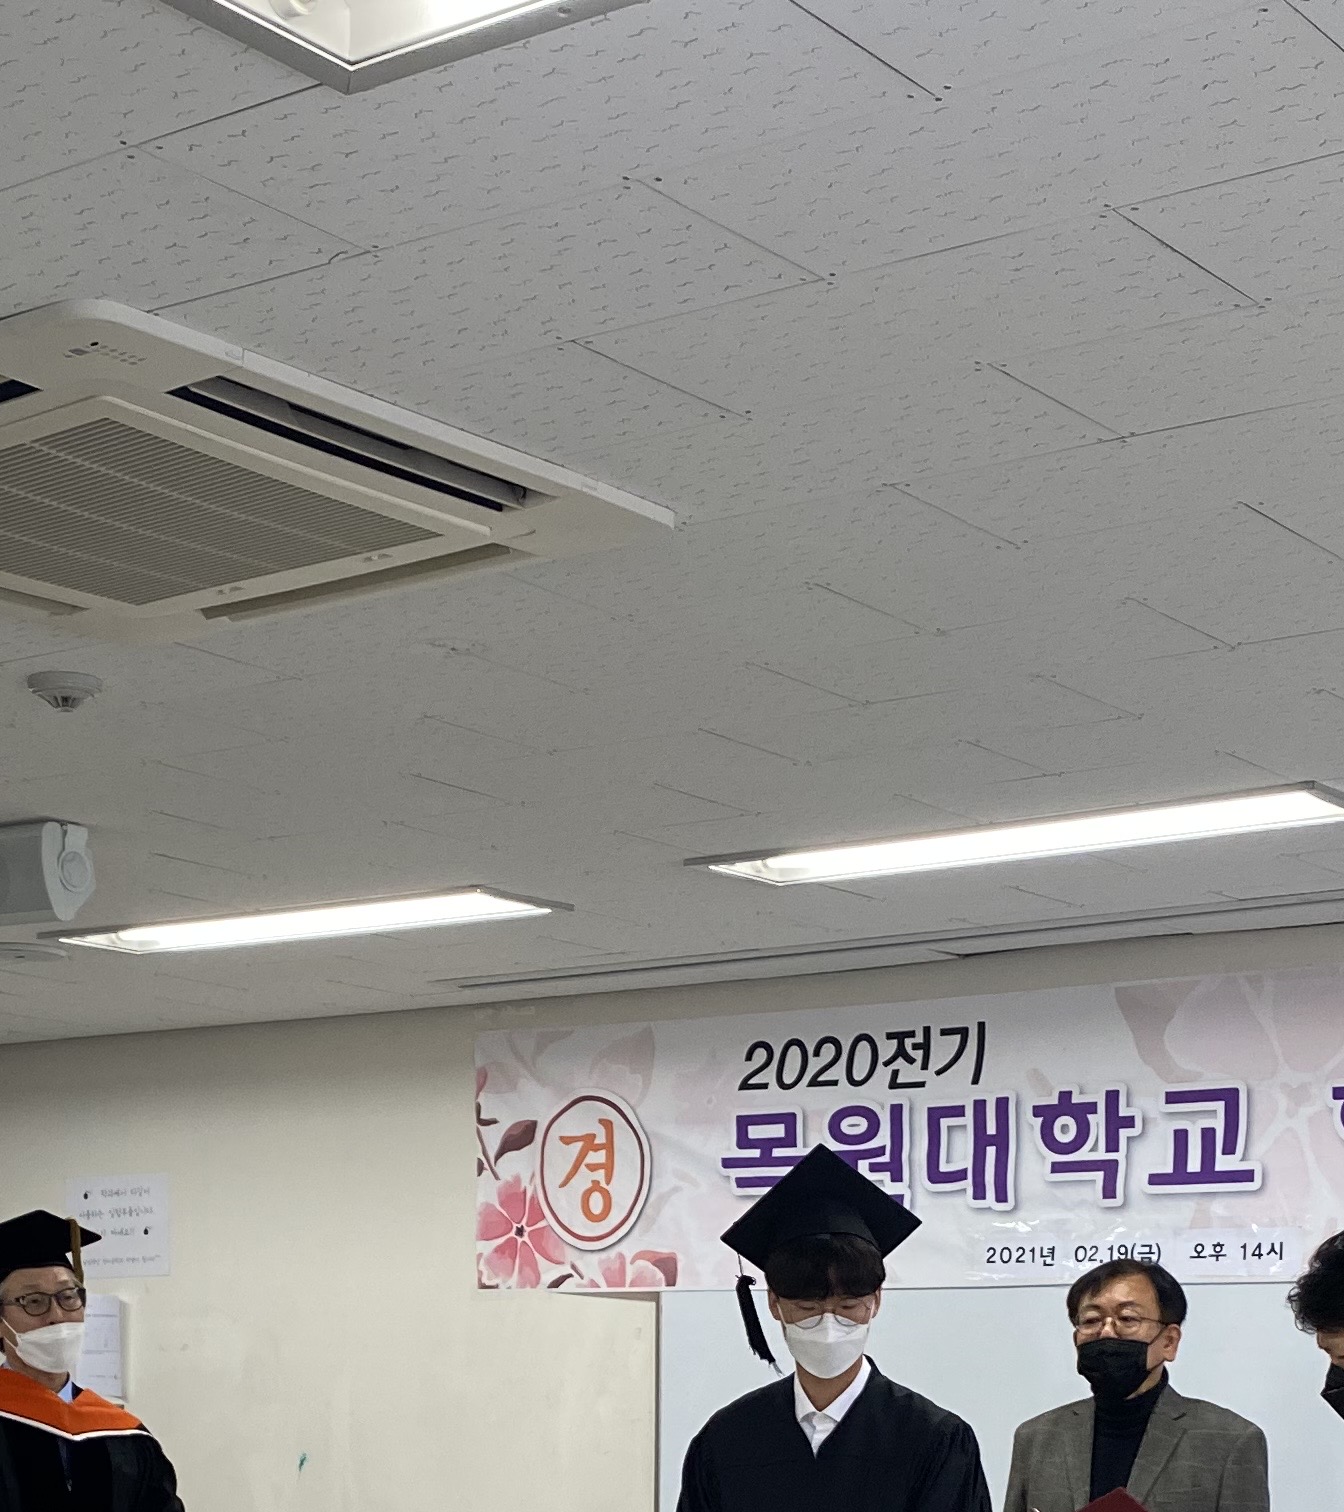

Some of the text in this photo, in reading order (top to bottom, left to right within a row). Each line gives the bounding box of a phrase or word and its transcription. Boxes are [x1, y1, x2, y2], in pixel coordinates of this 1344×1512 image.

[738, 1021, 989, 1091] 2020전기
[557, 1117, 617, 1224] 경
[720, 1085, 1264, 1209] 목원대학교
[985, 1240, 1284, 1267] 2021년 02.19(금) 오후 14시
